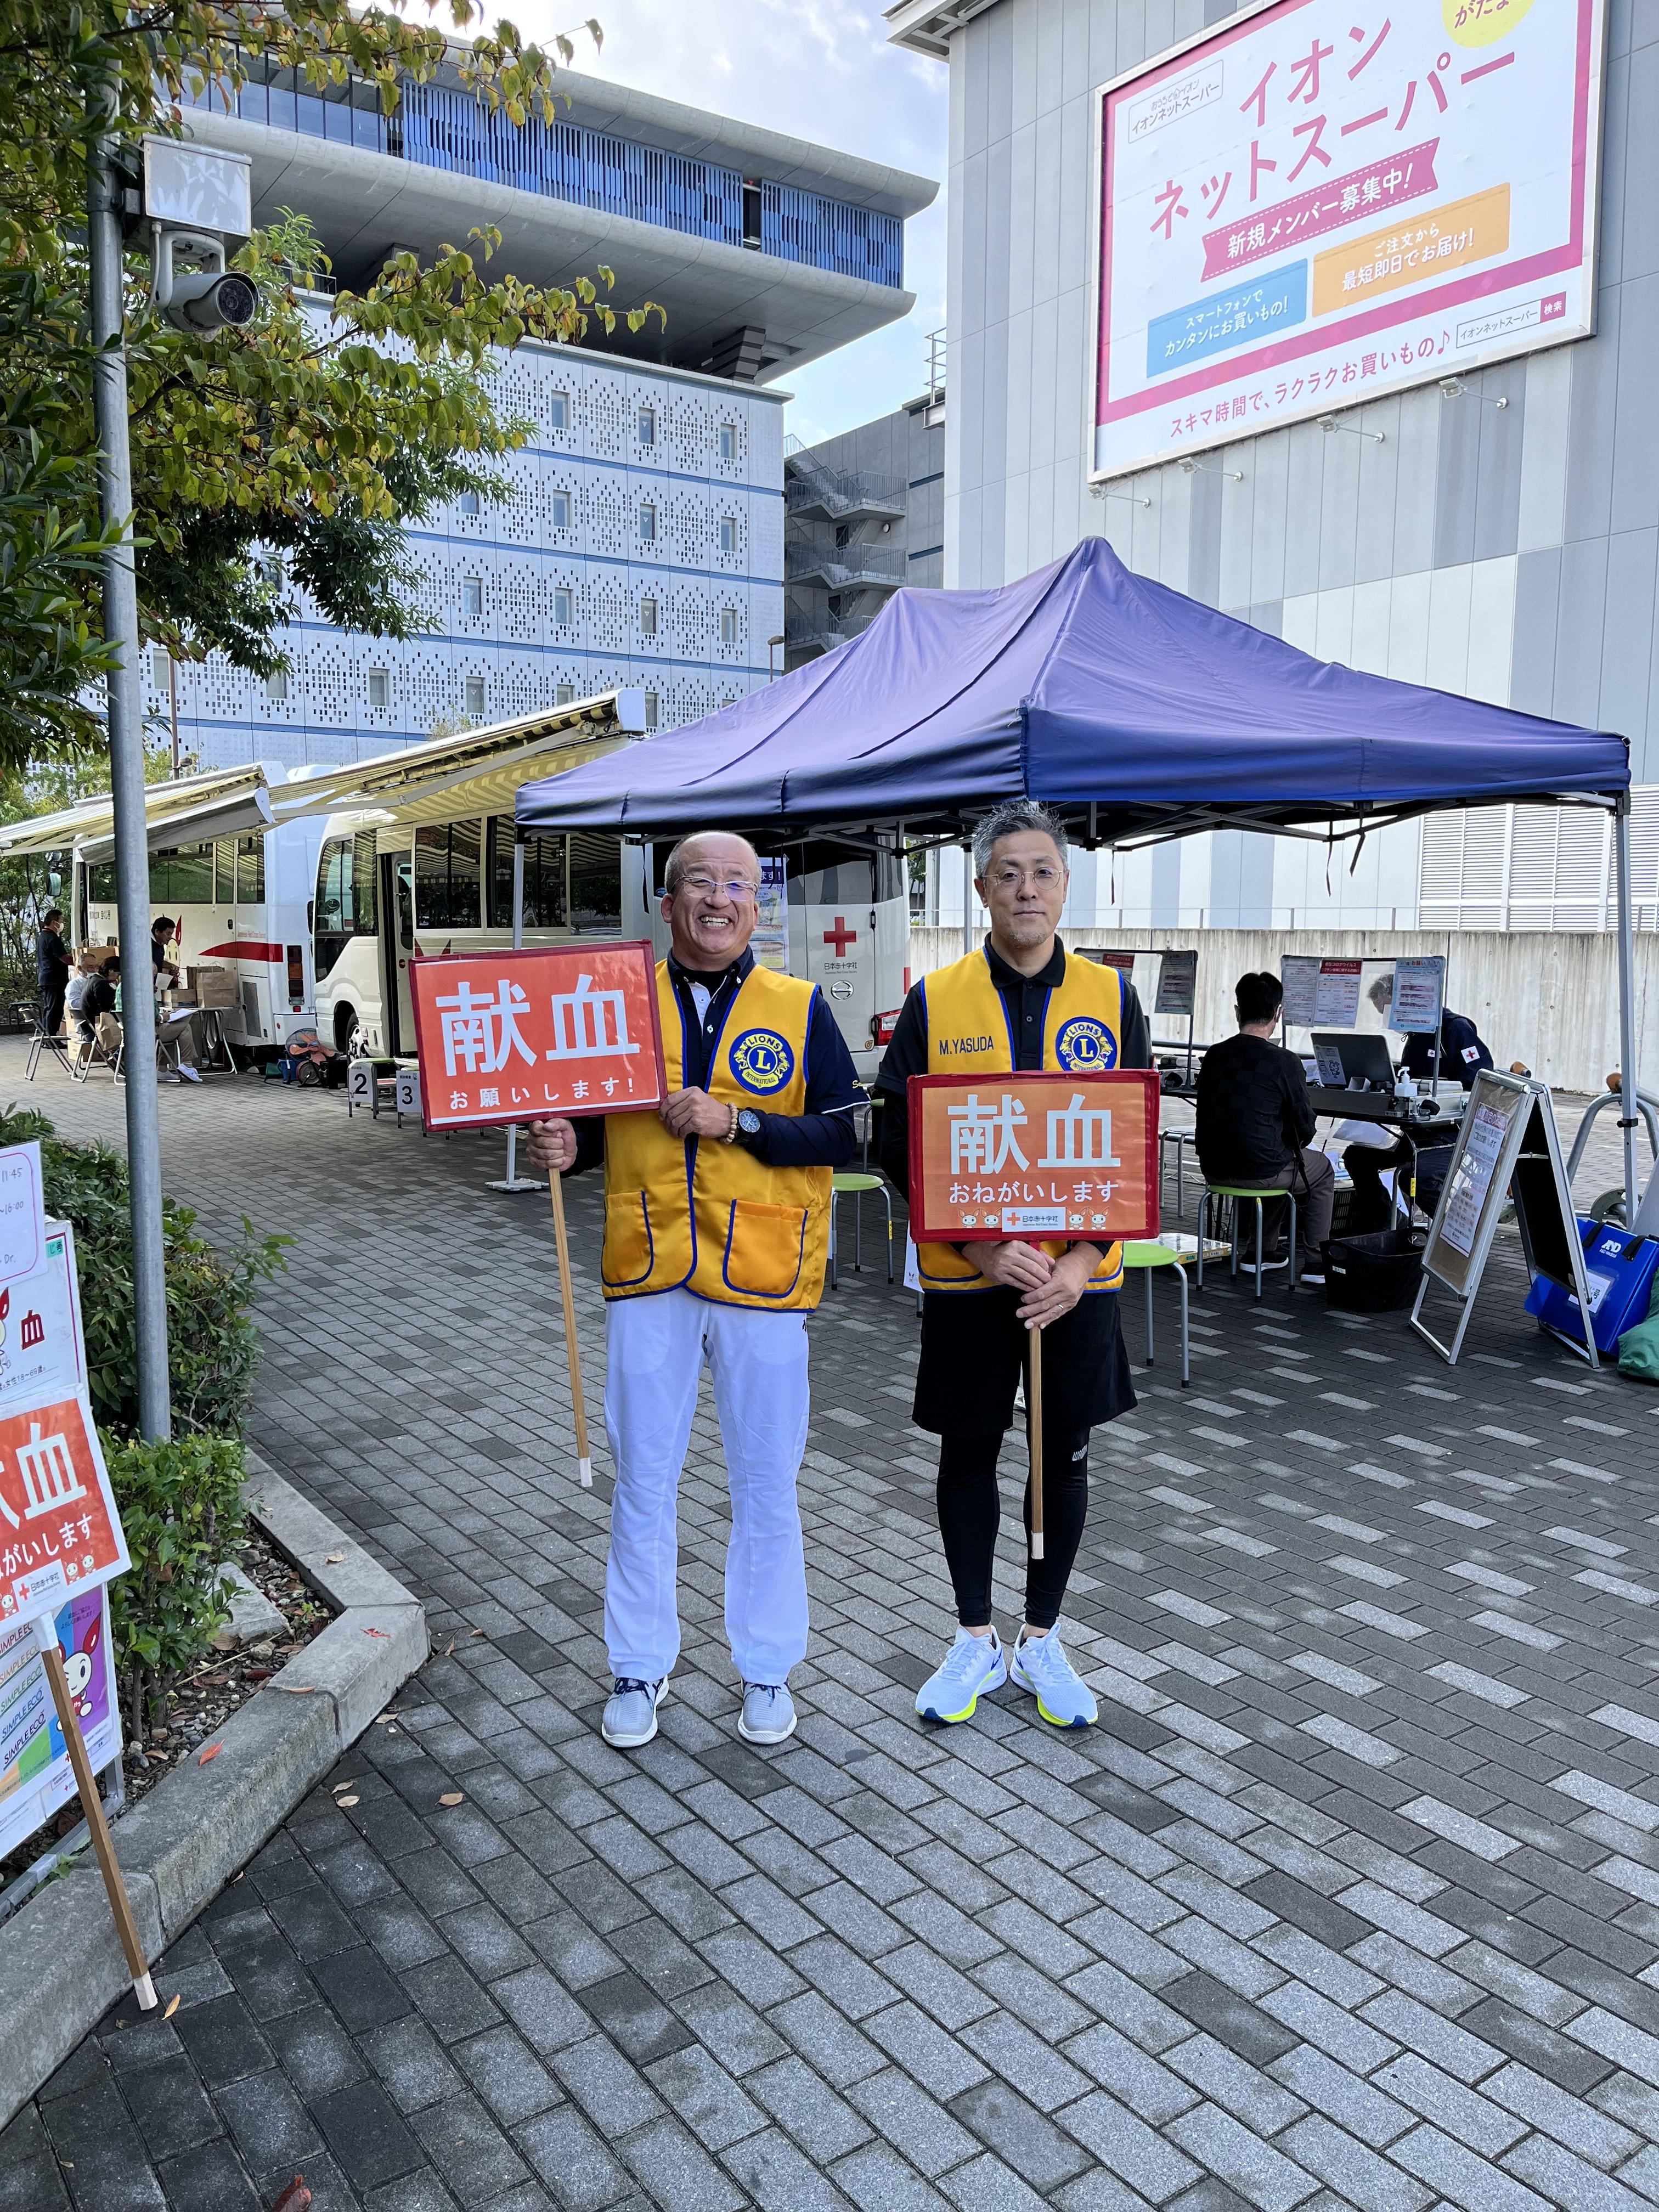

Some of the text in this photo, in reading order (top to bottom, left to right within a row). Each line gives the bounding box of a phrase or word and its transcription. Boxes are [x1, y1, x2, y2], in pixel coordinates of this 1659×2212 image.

[1239, 17, 1392, 128] イオン
[1132, 83, 1220, 134] イオンネットスーパー
[1149, 51, 1515, 240] ネットスーパー
[1374, 223, 1440, 258] ご注文から
[1186, 289, 1263, 329] スマートフォンで
[1460, 301, 1562, 340] イオンネットスーパー 検索
[436, 973, 640, 1077] 献血
[1069, 1024, 1100, 1036] LIONS
[748, 1035, 781, 1050] LIONS
[755, 1049, 771, 1070] L
[939, 1035, 994, 1055] M.YASUDA
[1079, 1038, 1094, 1058] L
[354, 1073, 368, 1094] 2
[402, 1085, 413, 1105] 3
[745, 1071, 776, 1085] INTERNATIONAL
[947, 1093, 1121, 1175] 献血
[949, 1179, 1119, 1204] おねがいします
[20, 1310, 45, 1351] 血
[0, 1422, 87, 1530] 血
[0, 1513, 93, 1580] がいします
[0, 1628, 23, 1655] IMPLE
[1, 1681, 26, 1713] SIMPLE
[2, 1706, 27, 1739] SIMPLE
[4, 1729, 29, 1765] SIMPLE
